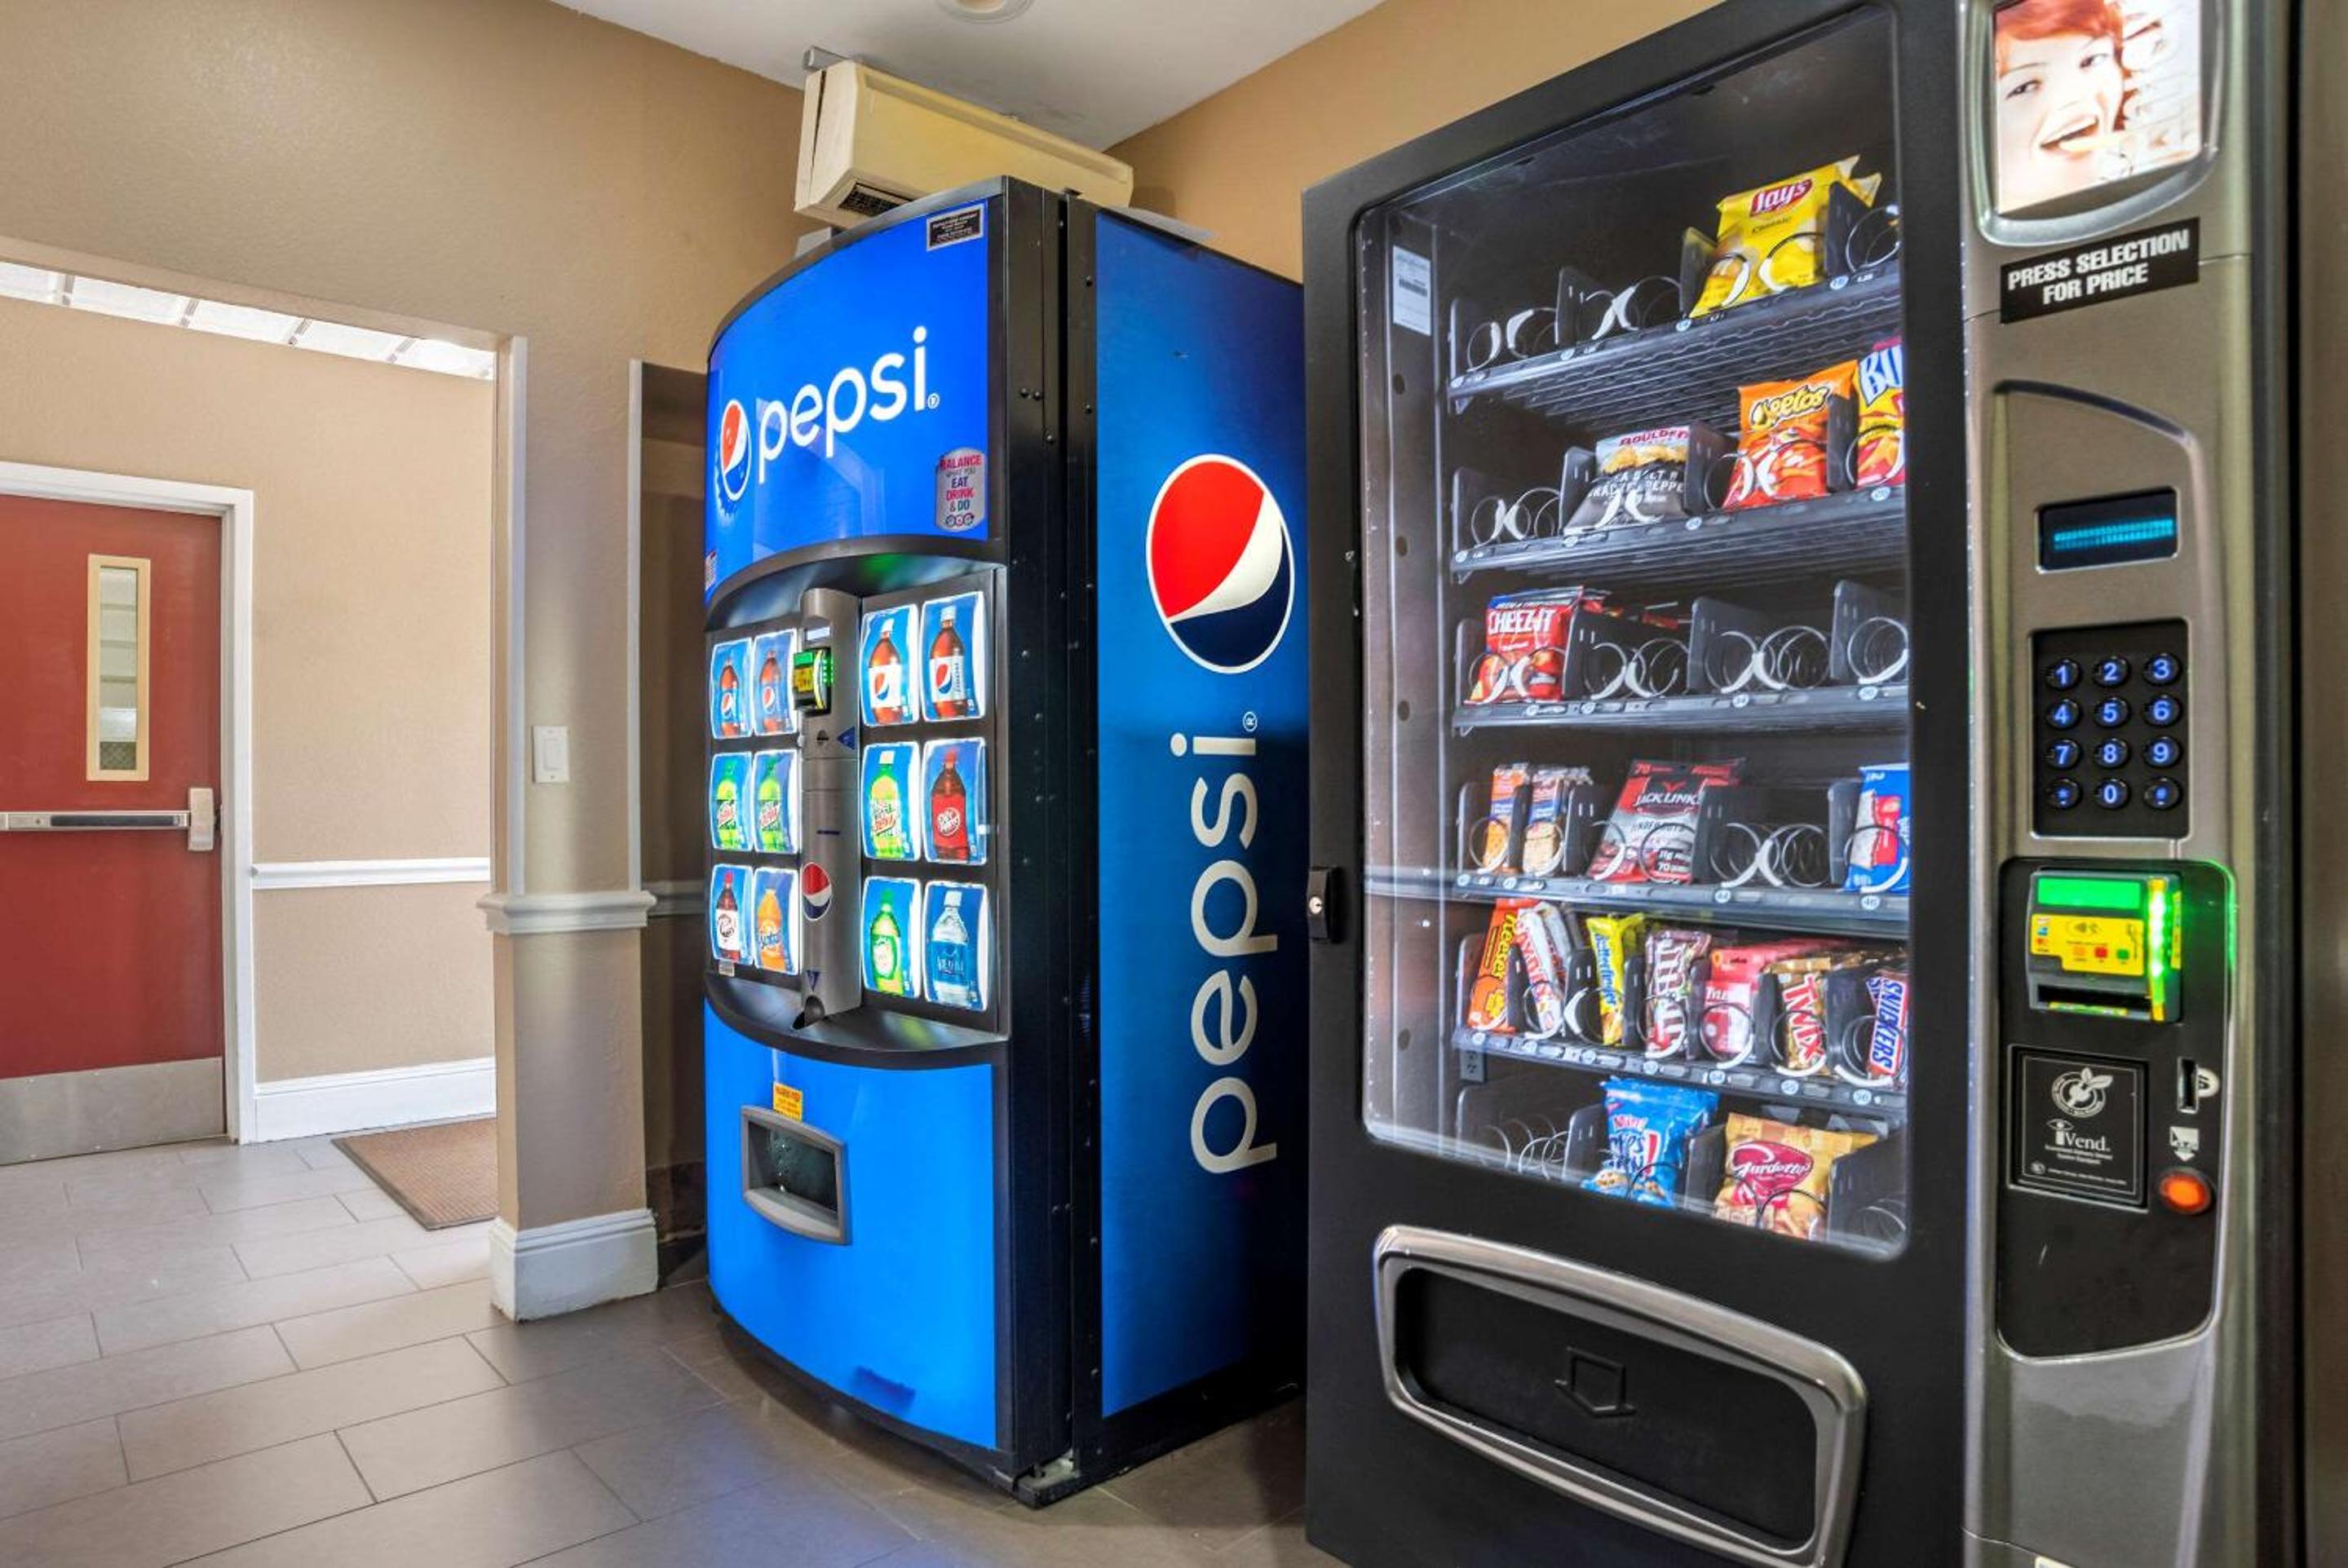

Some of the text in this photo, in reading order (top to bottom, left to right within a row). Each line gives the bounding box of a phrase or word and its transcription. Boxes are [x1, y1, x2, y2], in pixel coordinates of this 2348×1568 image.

[2008, 228, 2190, 290] PRESS SELECTION
[2043, 263, 2148, 305] FOR PRICE
[758, 325, 926, 484] pepsi
[940, 455, 982, 470] BALANCE
[951, 476, 968, 488] EAT
[957, 501, 971, 512] DO
[2055, 659, 2169, 685] 1 2 3
[2054, 700, 2170, 724] 4 5 6
[2055, 742, 2169, 765] 7 8 9
[2103, 784, 2117, 804] 0
[1170, 732, 1278, 1174] pepsi
[1782, 974, 1825, 1062] TWIX
[1872, 979, 1904, 1070] SNICKERS
